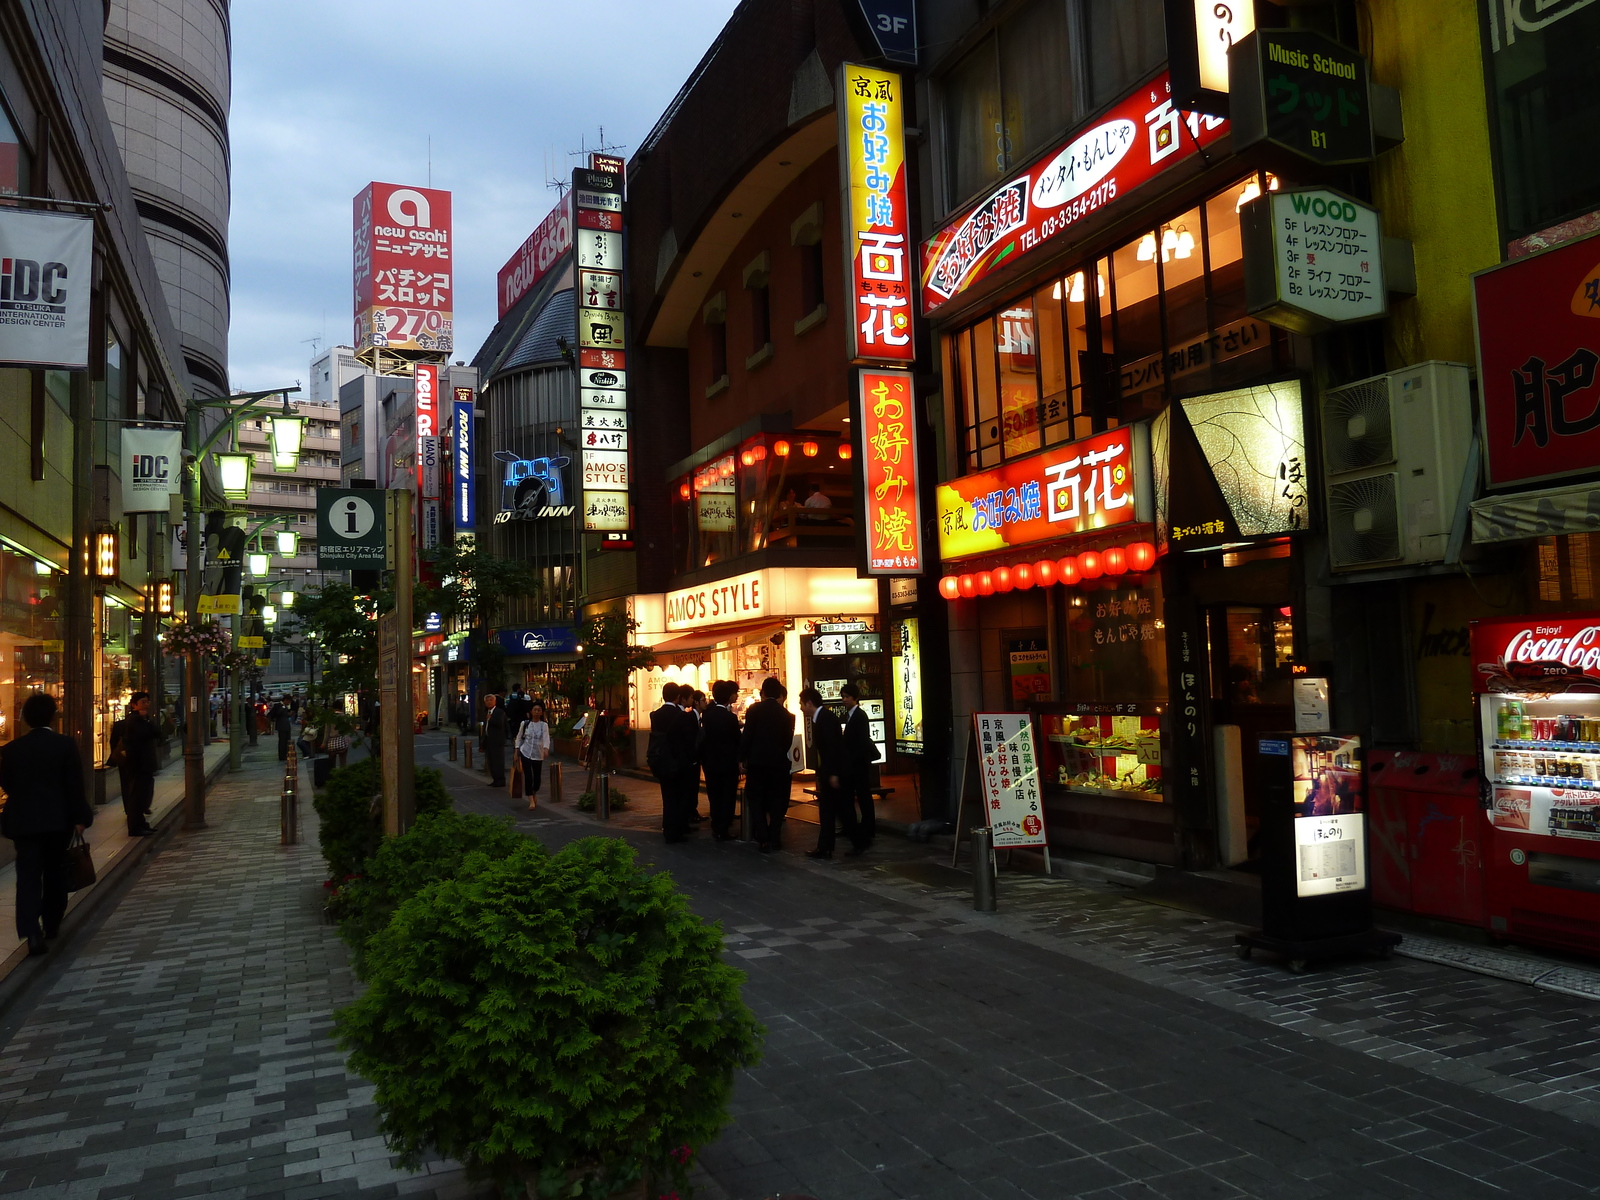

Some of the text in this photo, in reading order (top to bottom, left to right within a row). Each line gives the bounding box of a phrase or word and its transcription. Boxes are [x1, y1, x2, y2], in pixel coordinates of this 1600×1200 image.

[876, 13, 908, 34] 3F
[1268, 42, 1356, 80] Music School
[851, 75, 893, 102] 京風
[1268, 73, 1361, 127] ウッド
[1310, 129, 1327, 149] B1
[860, 103, 894, 228] お好み焼
[1020, 178, 1117, 252] TEL. 03-3354-2175
[1290, 193, 1357, 223] WOOD
[361, 190, 373, 278] パチンコ
[374, 225, 448, 243] new asahi
[938, 187, 1021, 292] お好み焼
[1284, 218, 1367, 241] 5F レッスンフロアー
[375, 239, 449, 260] ニューアサヒ
[1285, 234, 1368, 256] 4F レッスンフロアー
[1286, 250, 1300, 263] 3F
[353, 228, 362, 312] スロット
[374, 267, 450, 290] パチンコ
[505, 248, 535, 308] new
[1287, 265, 1301, 279] 2F
[377, 284, 446, 307] スロット
[857, 230, 910, 346] 百花
[860, 280, 905, 294] ももか
[1289, 282, 1372, 302] B2 レッスンフロアー
[14, 303, 52, 312] OTSUKA
[0, 317, 66, 329] DESIGN CENTER
[373, 310, 387, 333] 全品
[417, 369, 432, 411] new
[459, 408, 469, 453] ROCK
[585, 415, 625, 428] 炭火焼
[425, 439, 436, 467] MANO
[459, 449, 470, 480] INN
[585, 452, 595, 460] 1F
[133, 454, 169, 480] iDC
[585, 462, 627, 473] AMO'S
[870, 380, 914, 552] お好み焼
[585, 473, 627, 484] STYLE
[941, 443, 1129, 536] 京風 お好み焼 百花
[493, 505, 576, 525] ROCK INN
[319, 545, 385, 553] 新宿区エリアマップ
[895, 556, 918, 567] ももか
[667, 579, 760, 624] AMO'S STYLE
[1095, 597, 1152, 618] お好み焼
[1094, 624, 1155, 645] もんじゃ焼
[1535, 626, 1562, 636] Enjoy!
[524, 639, 547, 649] ROCK
[1543, 666, 1568, 676] zero
[1126, 703, 1137, 713] 2F
[1180, 671, 1197, 737] ほんのり
[981, 718, 1001, 810] 月島風もんじゃ焼
[993, 718, 1012, 790] 京風お好み焼
[1141, 748, 1159, 760] 入口
[1008, 743, 1025, 800] 味自慢の店
[1313, 827, 1343, 842] ほんのり
